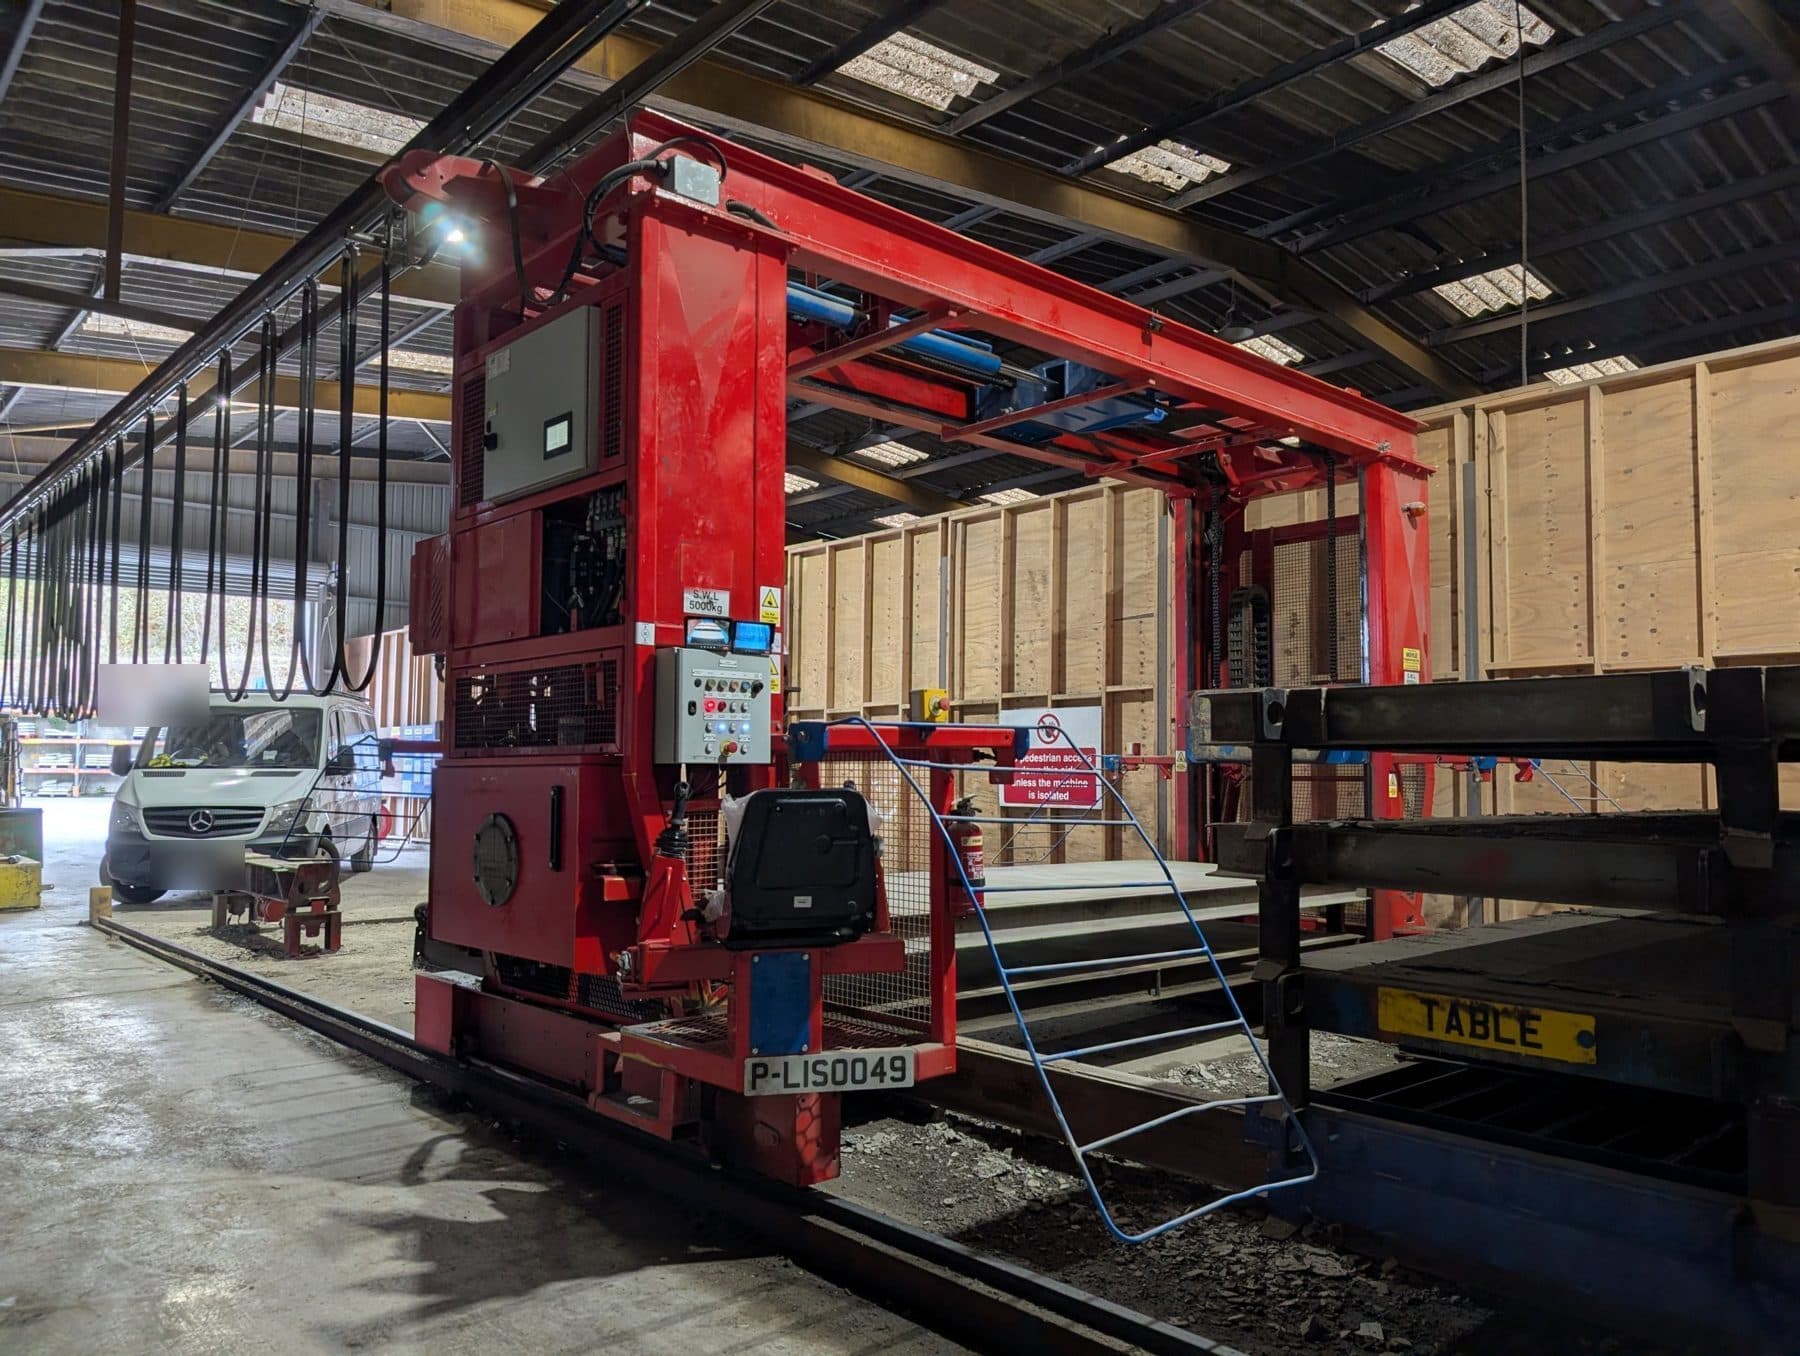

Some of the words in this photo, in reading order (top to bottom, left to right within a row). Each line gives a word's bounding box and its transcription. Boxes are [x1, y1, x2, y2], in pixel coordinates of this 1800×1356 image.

[689, 600, 722, 615] 5000kg
[1063, 754, 1092, 763] acces
[1011, 778, 1036, 787] nless
[1038, 778, 1051, 787] the
[1028, 790, 1035, 800] is
[1419, 998, 1543, 1049] TABLE
